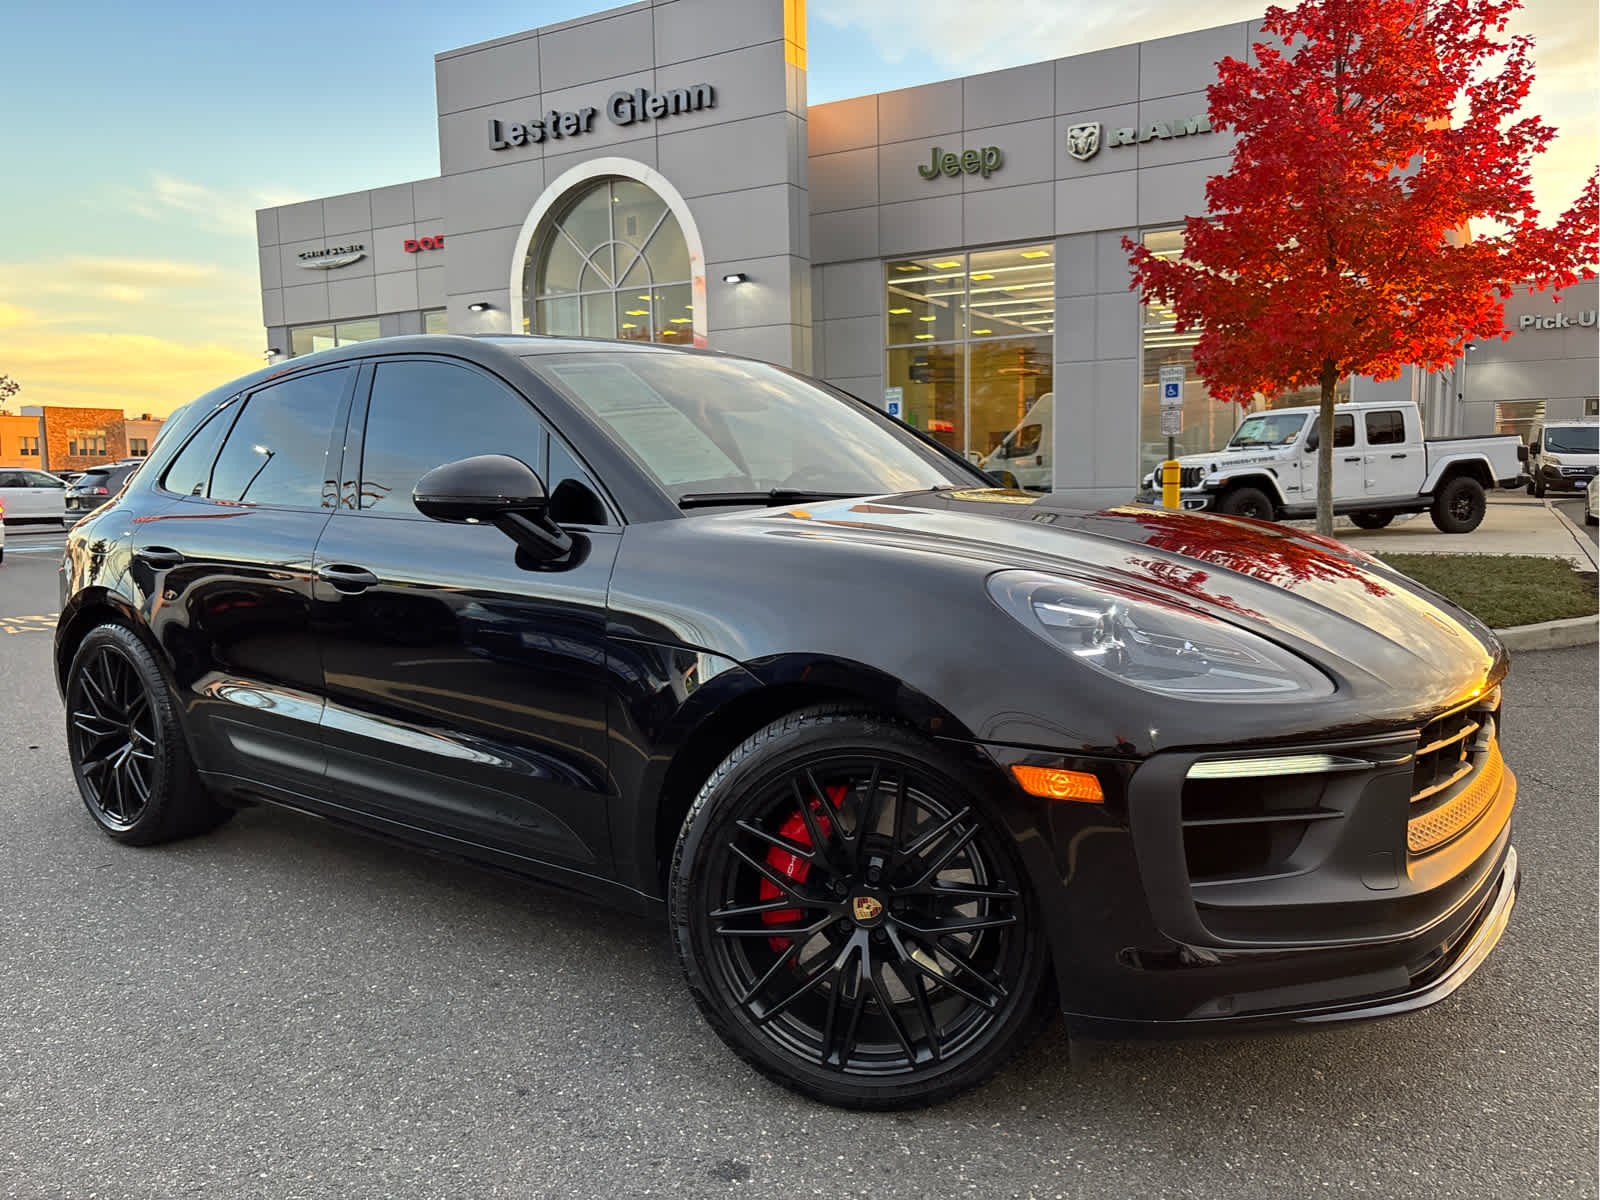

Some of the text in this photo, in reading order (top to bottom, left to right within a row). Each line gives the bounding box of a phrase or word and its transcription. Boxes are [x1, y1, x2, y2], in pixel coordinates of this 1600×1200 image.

[488, 82, 715, 150] Lester Glenn
[1107, 113, 1212, 148] RAM
[918, 145, 1003, 181] Jeep
[1520, 311, 1599, 330] Pick-U
